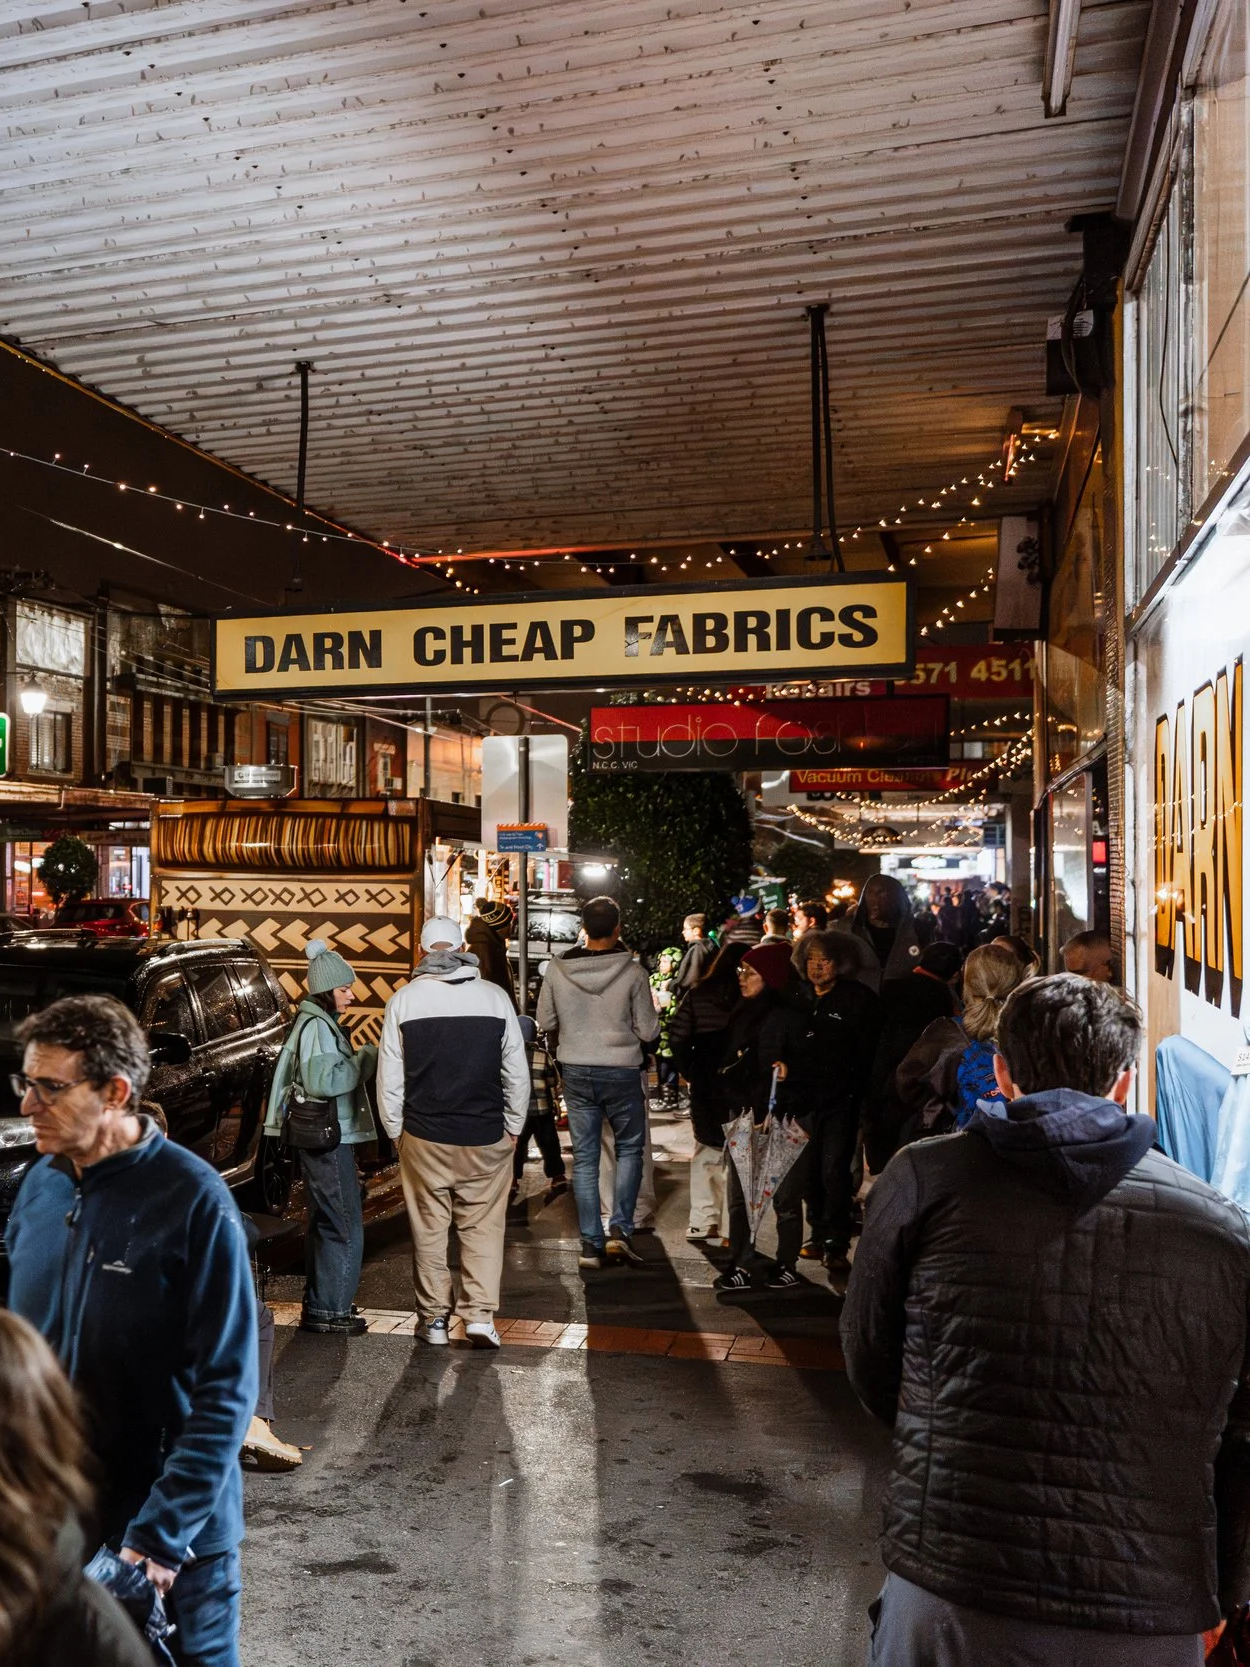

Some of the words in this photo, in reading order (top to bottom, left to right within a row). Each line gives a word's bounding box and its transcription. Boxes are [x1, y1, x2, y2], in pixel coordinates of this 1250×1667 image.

[244, 629, 382, 674] DARN
[413, 618, 596, 667] CHEAP
[623, 603, 879, 659] FABRICS
[895, 661, 958, 685] 571
[593, 714, 738, 759] studio
[621, 760, 638, 770] VIC
[796, 769, 862, 783] Vacuum
[1155, 654, 1243, 1010] DARN
